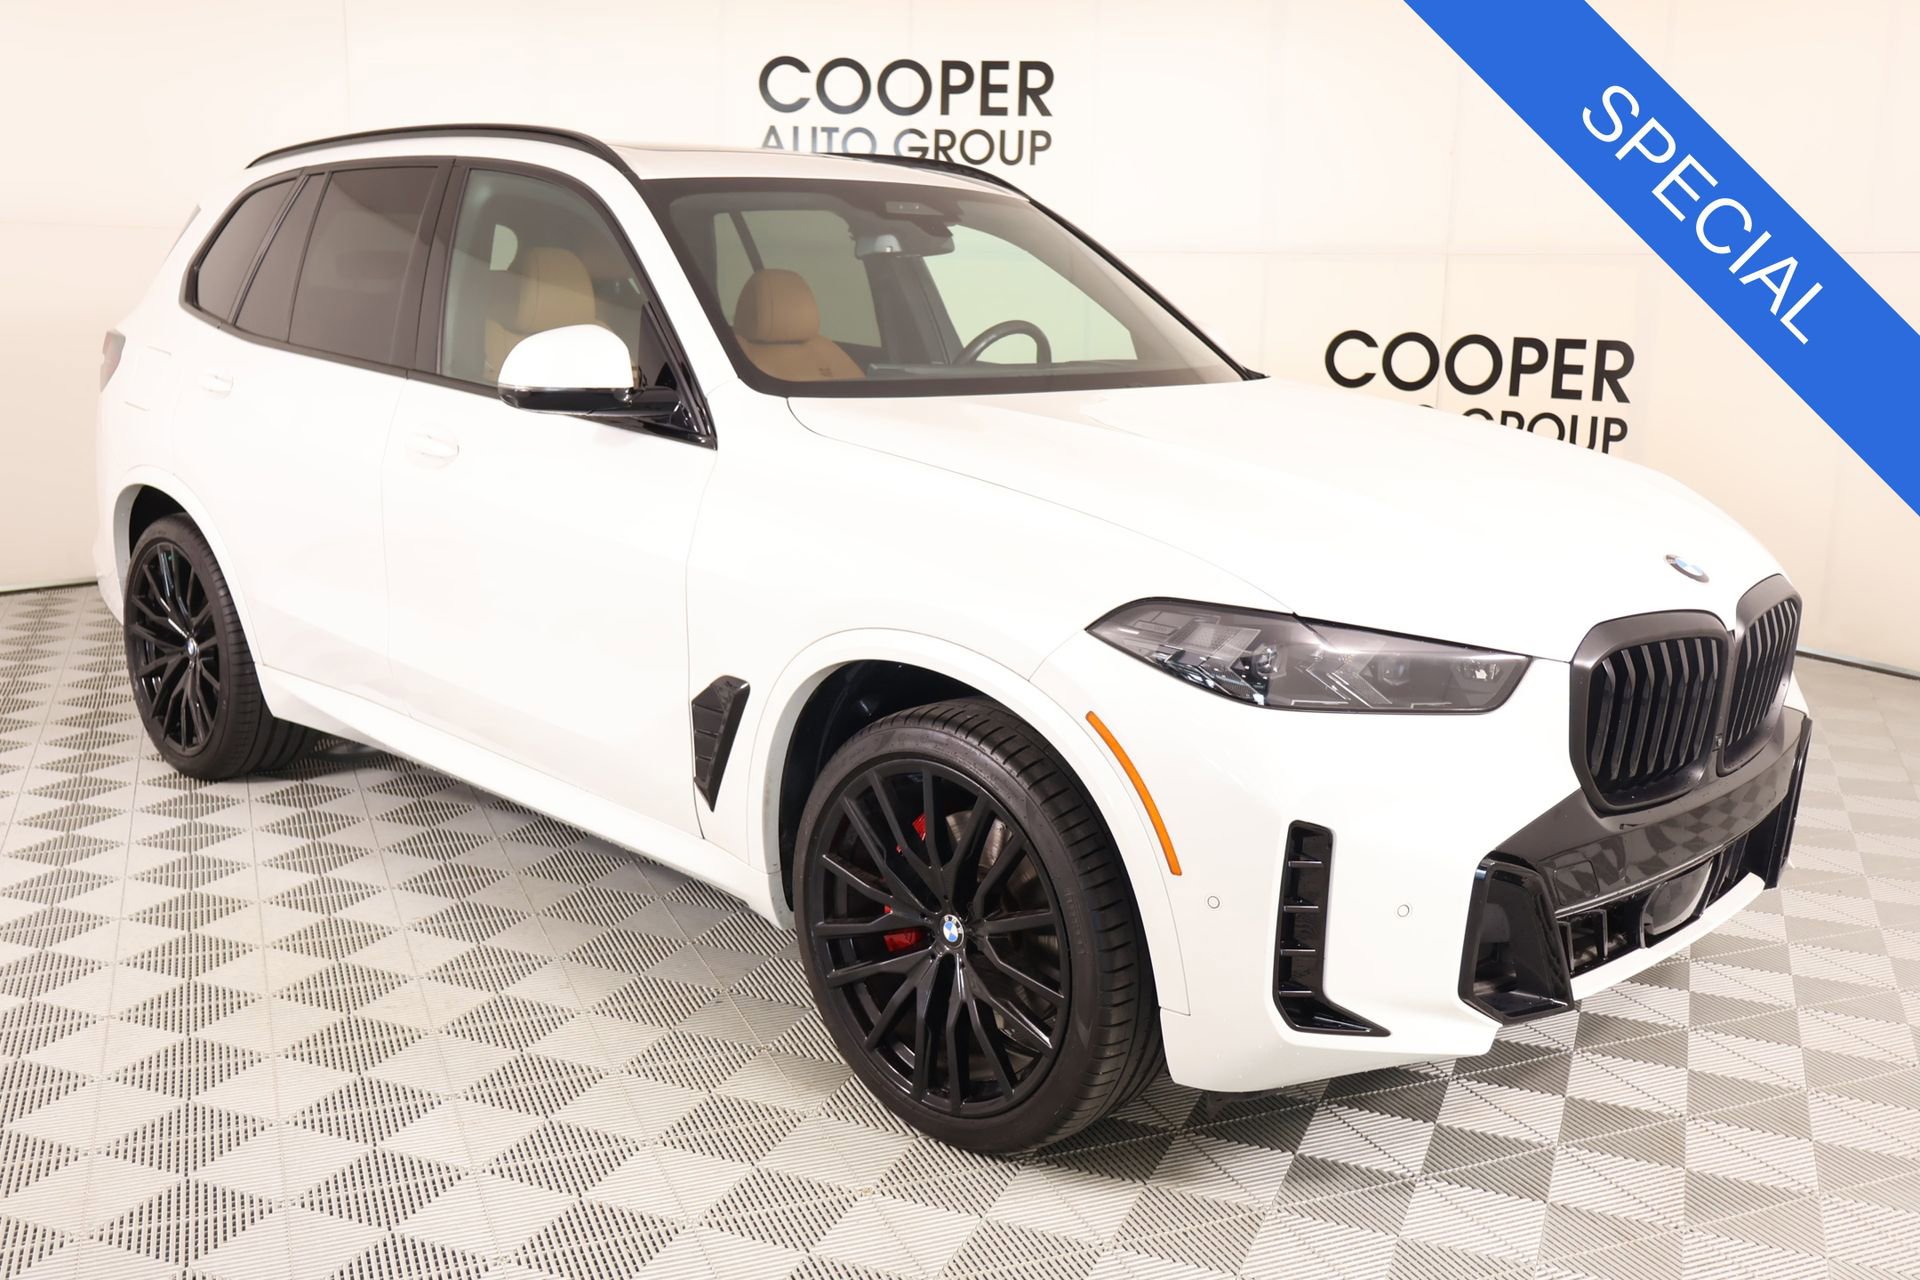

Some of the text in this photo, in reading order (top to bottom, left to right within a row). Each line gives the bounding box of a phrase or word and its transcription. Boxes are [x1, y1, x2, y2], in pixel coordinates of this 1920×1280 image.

[759, 55, 1054, 117] COOPER
[762, 125, 1052, 166] AUTO GROUP
[1325, 329, 1635, 404] COOPER
[1462, 408, 1628, 454] OUP
